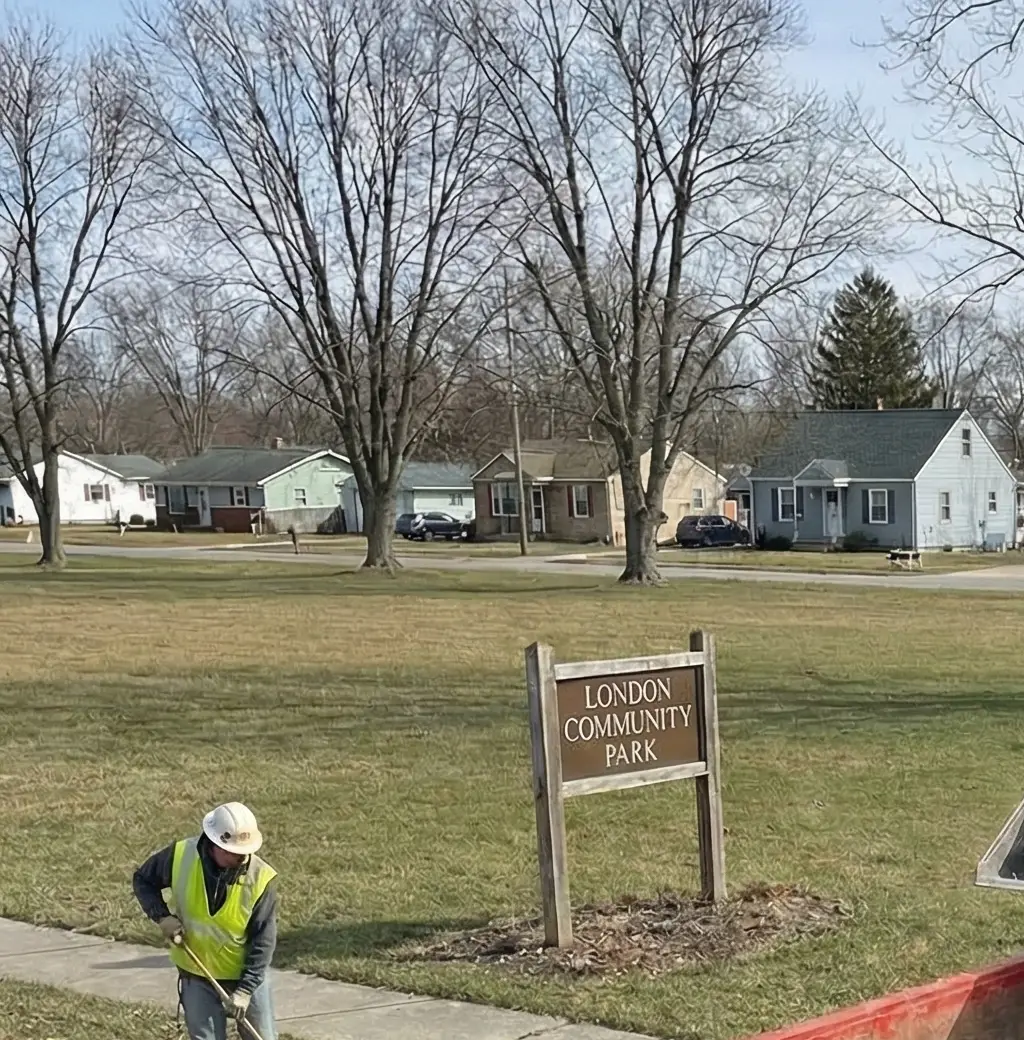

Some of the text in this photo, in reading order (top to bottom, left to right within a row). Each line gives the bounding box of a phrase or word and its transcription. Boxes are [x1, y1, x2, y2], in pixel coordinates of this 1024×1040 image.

[585, 677, 671, 709] LONDON
[564, 704, 692, 742] COMMUNITY
[605, 738, 658, 768] PARK
